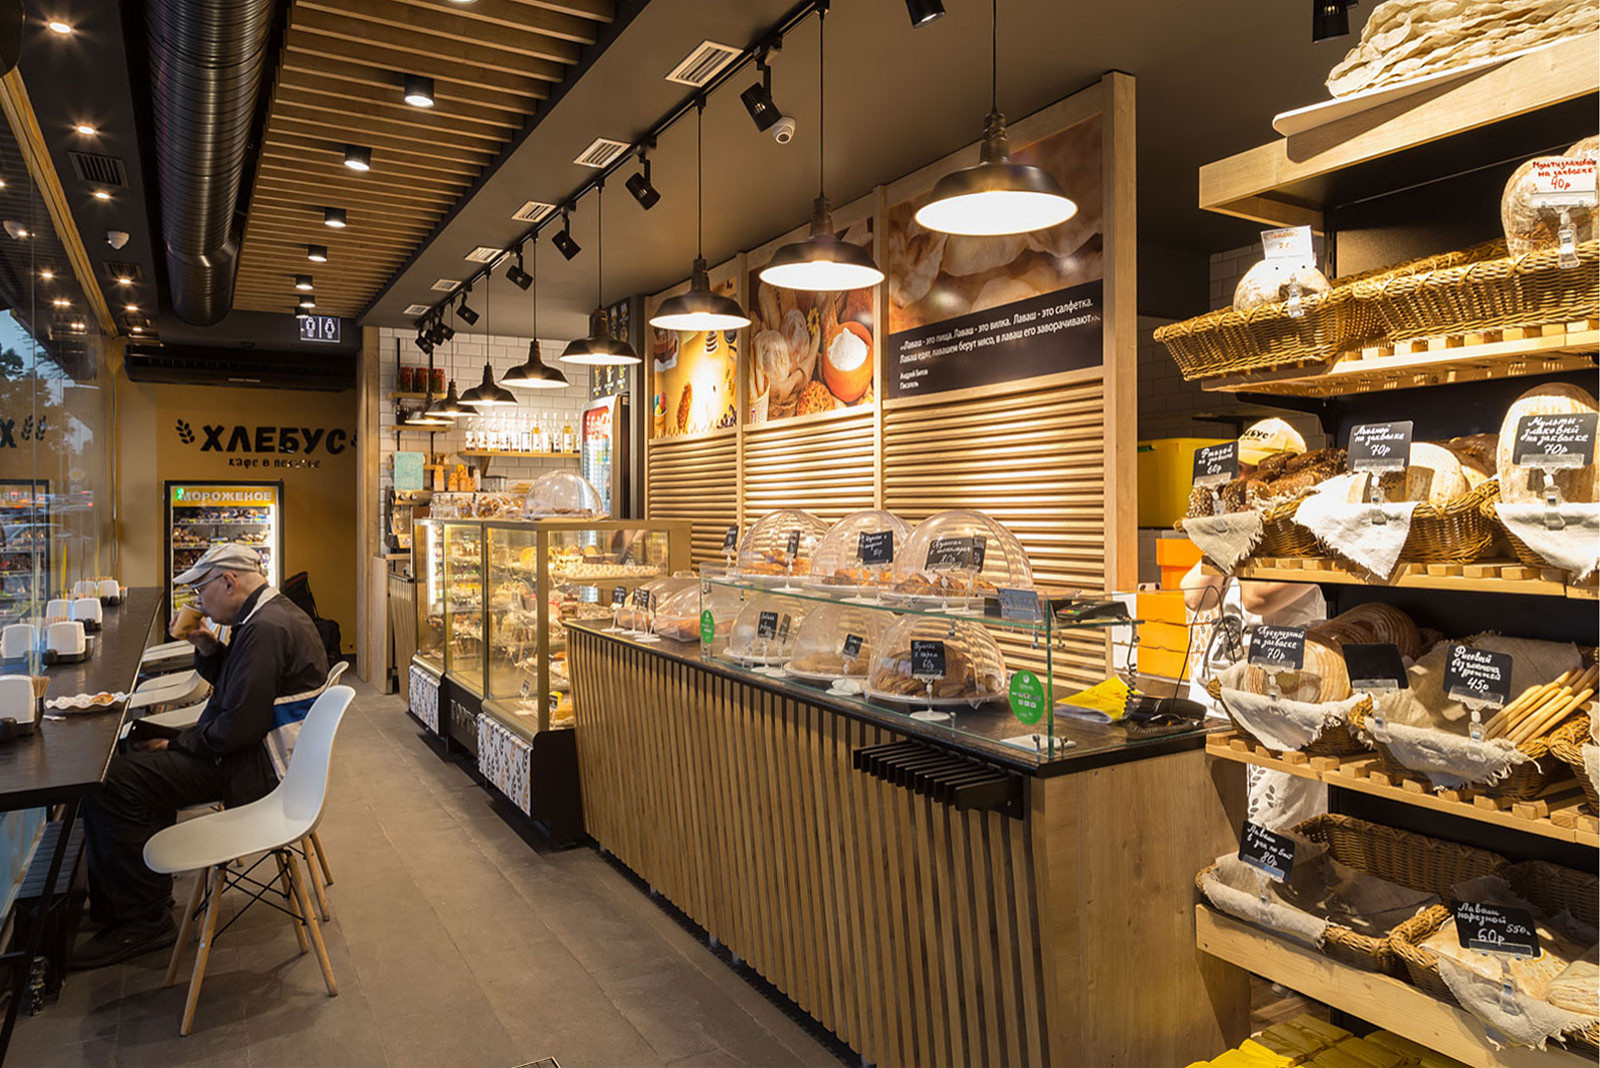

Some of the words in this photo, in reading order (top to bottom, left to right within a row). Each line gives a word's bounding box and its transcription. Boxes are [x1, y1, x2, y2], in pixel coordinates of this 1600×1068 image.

[1551, 178, 1570, 190] 40р
[926, 337, 935, 345] это
[954, 327, 974, 338] Лаваш
[978, 323, 989, 333] это
[990, 318, 1011, 331] вилка.
[1013, 312, 1037, 324] Лаваш
[1042, 308, 1054, 318] это
[1055, 298, 1093, 314] салфетка.
[900, 354, 917, 364] Лаваш
[959, 340, 976, 352] берут
[977, 336, 995, 347] мясо,
[1001, 329, 1023, 342] лаваш
[1024, 327, 1036, 338] его
[201, 424, 346, 455] ХЛЕБУС
[1537, 434, 1589, 446] закваске
[1370, 444, 1391, 457] 70р
[1544, 444, 1568, 456] 70р
[229, 457, 258, 470] кафе
[263, 458, 270, 467] в
[181, 491, 272, 501] МОРОЖЕНОЕ
[1267, 648, 1285, 663] 70р
[1454, 645, 1492, 663] Рисовый
[1467, 677, 1489, 693] 45р
[1247, 824, 1276, 843] Лаваш
[1247, 833, 1253, 841] в
[1260, 851, 1278, 867] 80р
[1458, 902, 1500, 916] Лаваш
[1457, 912, 1506, 927] нарезной
[1478, 928, 1505, 947] 60р
